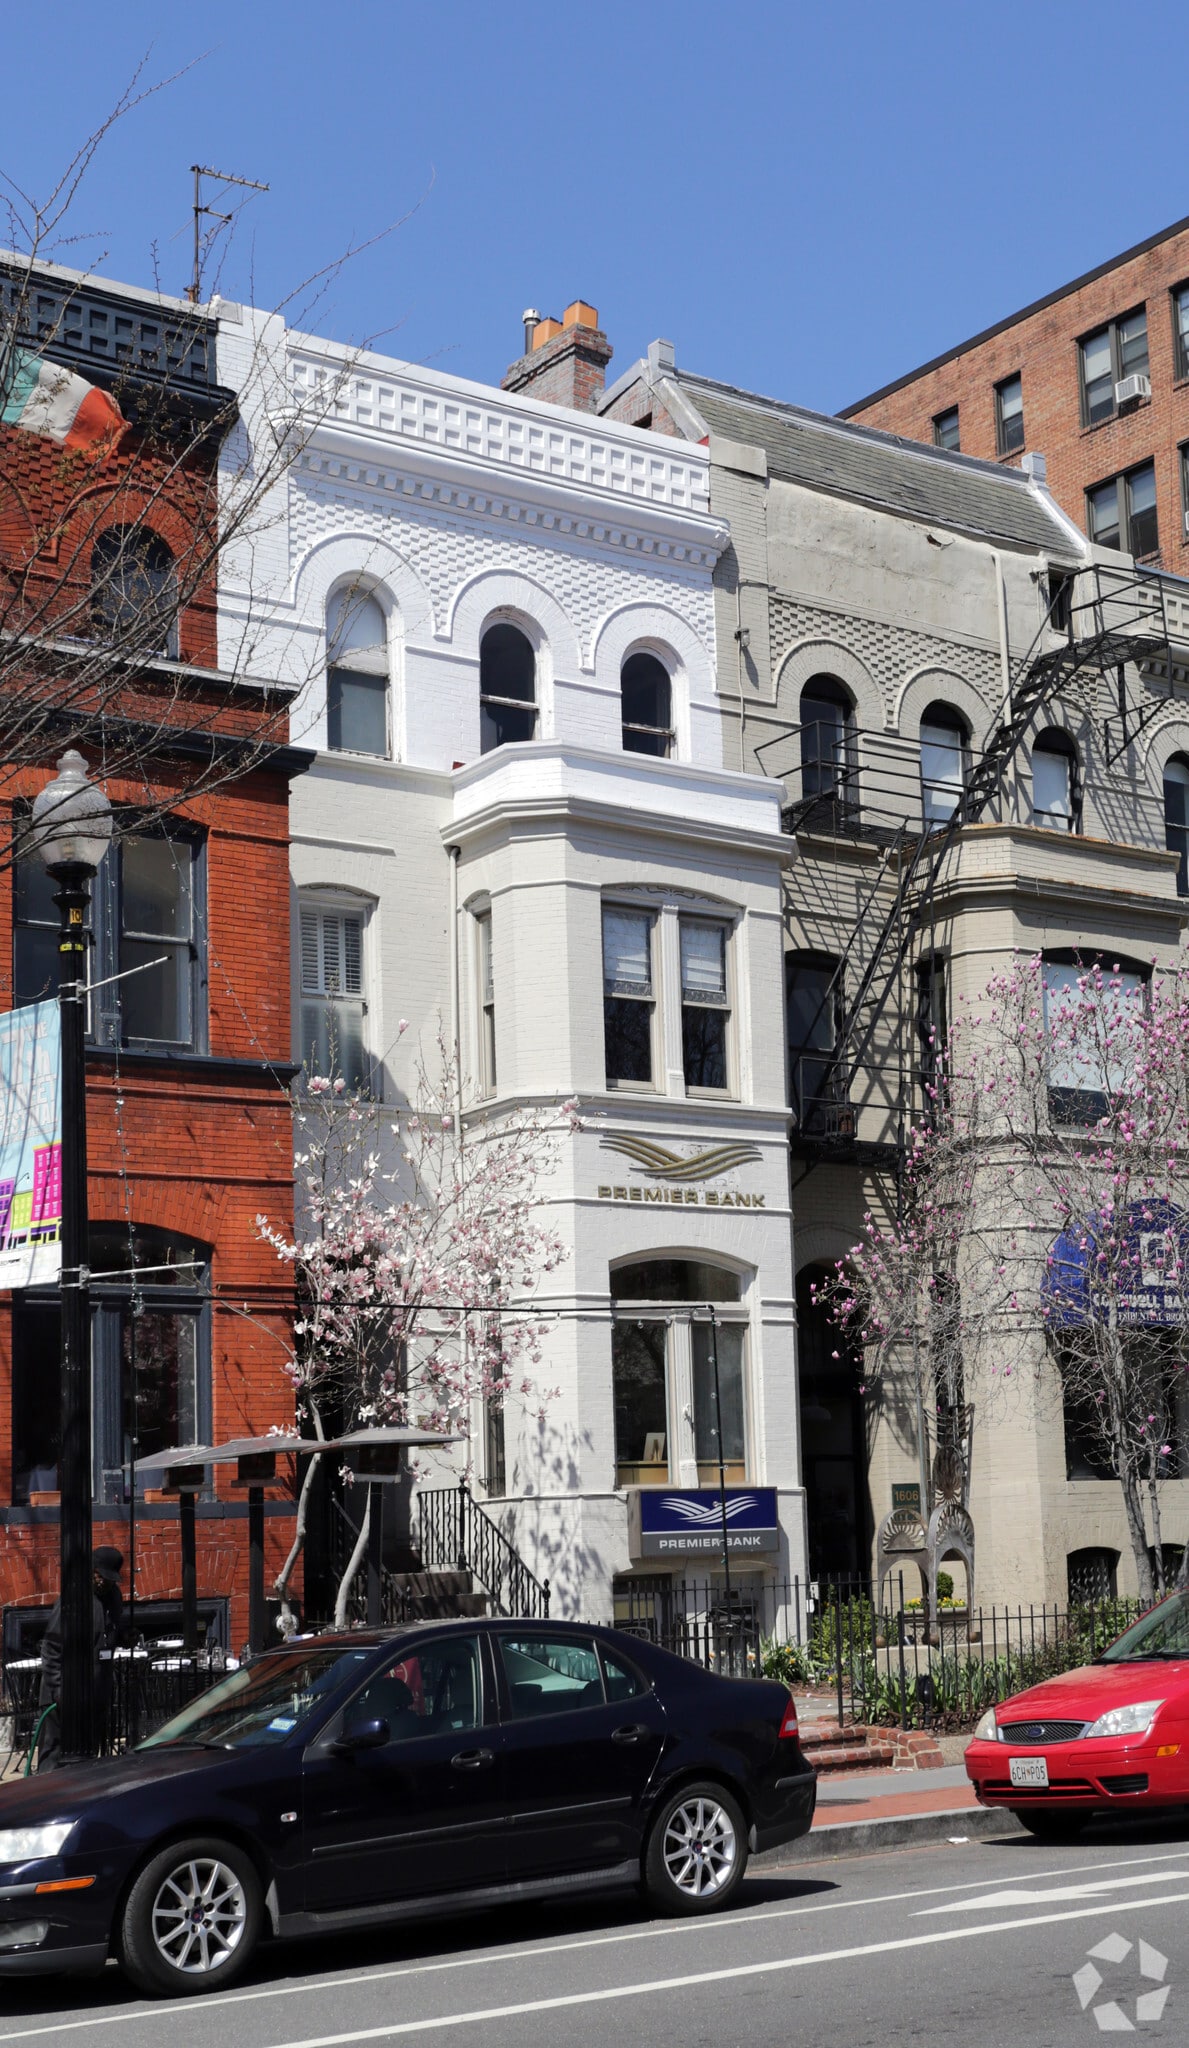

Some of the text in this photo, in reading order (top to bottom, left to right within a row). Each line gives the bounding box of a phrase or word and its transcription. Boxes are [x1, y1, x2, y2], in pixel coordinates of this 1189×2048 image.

[598, 1186, 765, 1207] PREMIER BANK
[895, 1490, 919, 1501] 1606
[659, 1536, 761, 1549] PREMIER BANK
